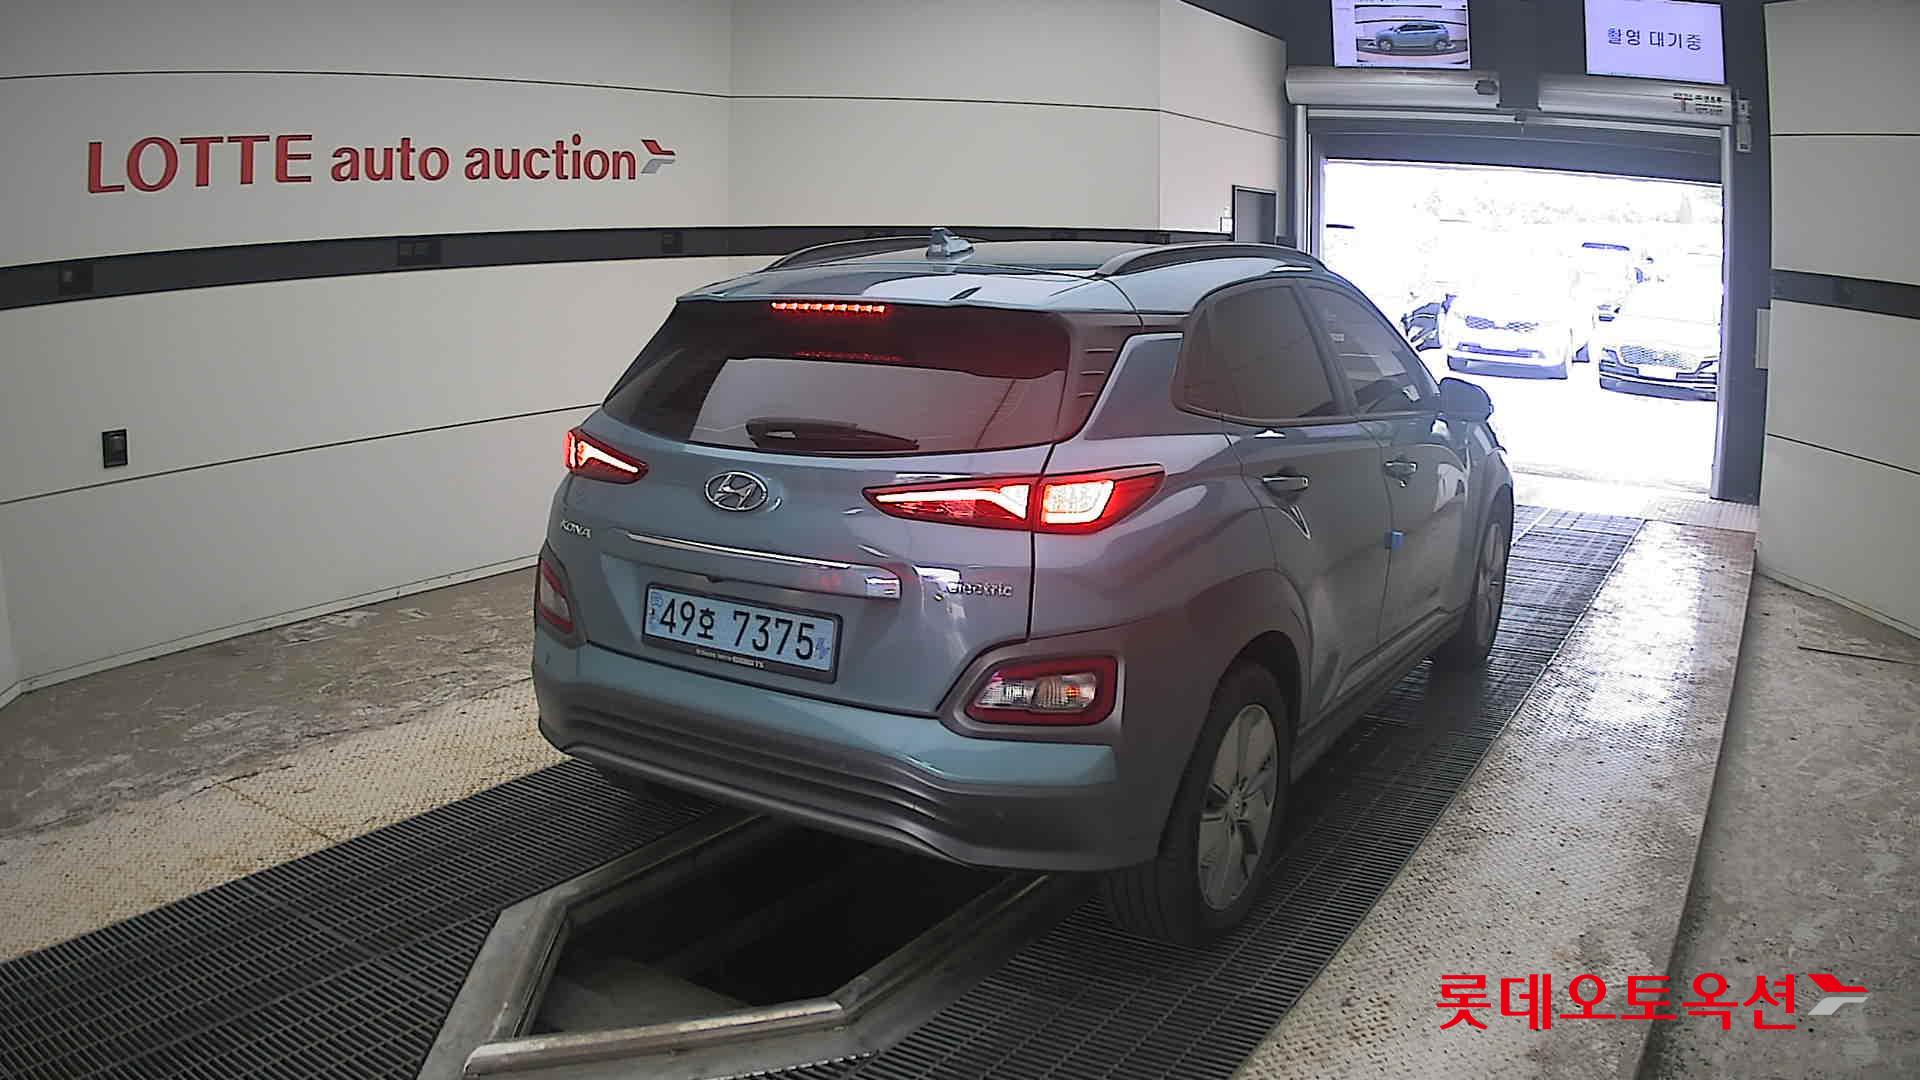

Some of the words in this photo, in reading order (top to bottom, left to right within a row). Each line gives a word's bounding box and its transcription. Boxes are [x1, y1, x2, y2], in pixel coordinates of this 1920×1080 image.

[87, 134, 313, 194] LOTTE
[330, 137, 450, 182] auto
[464, 134, 638, 182] auction
[561, 519, 591, 539] KONA
[659, 598, 716, 640] 49호
[733, 609, 815, 660] 7375
